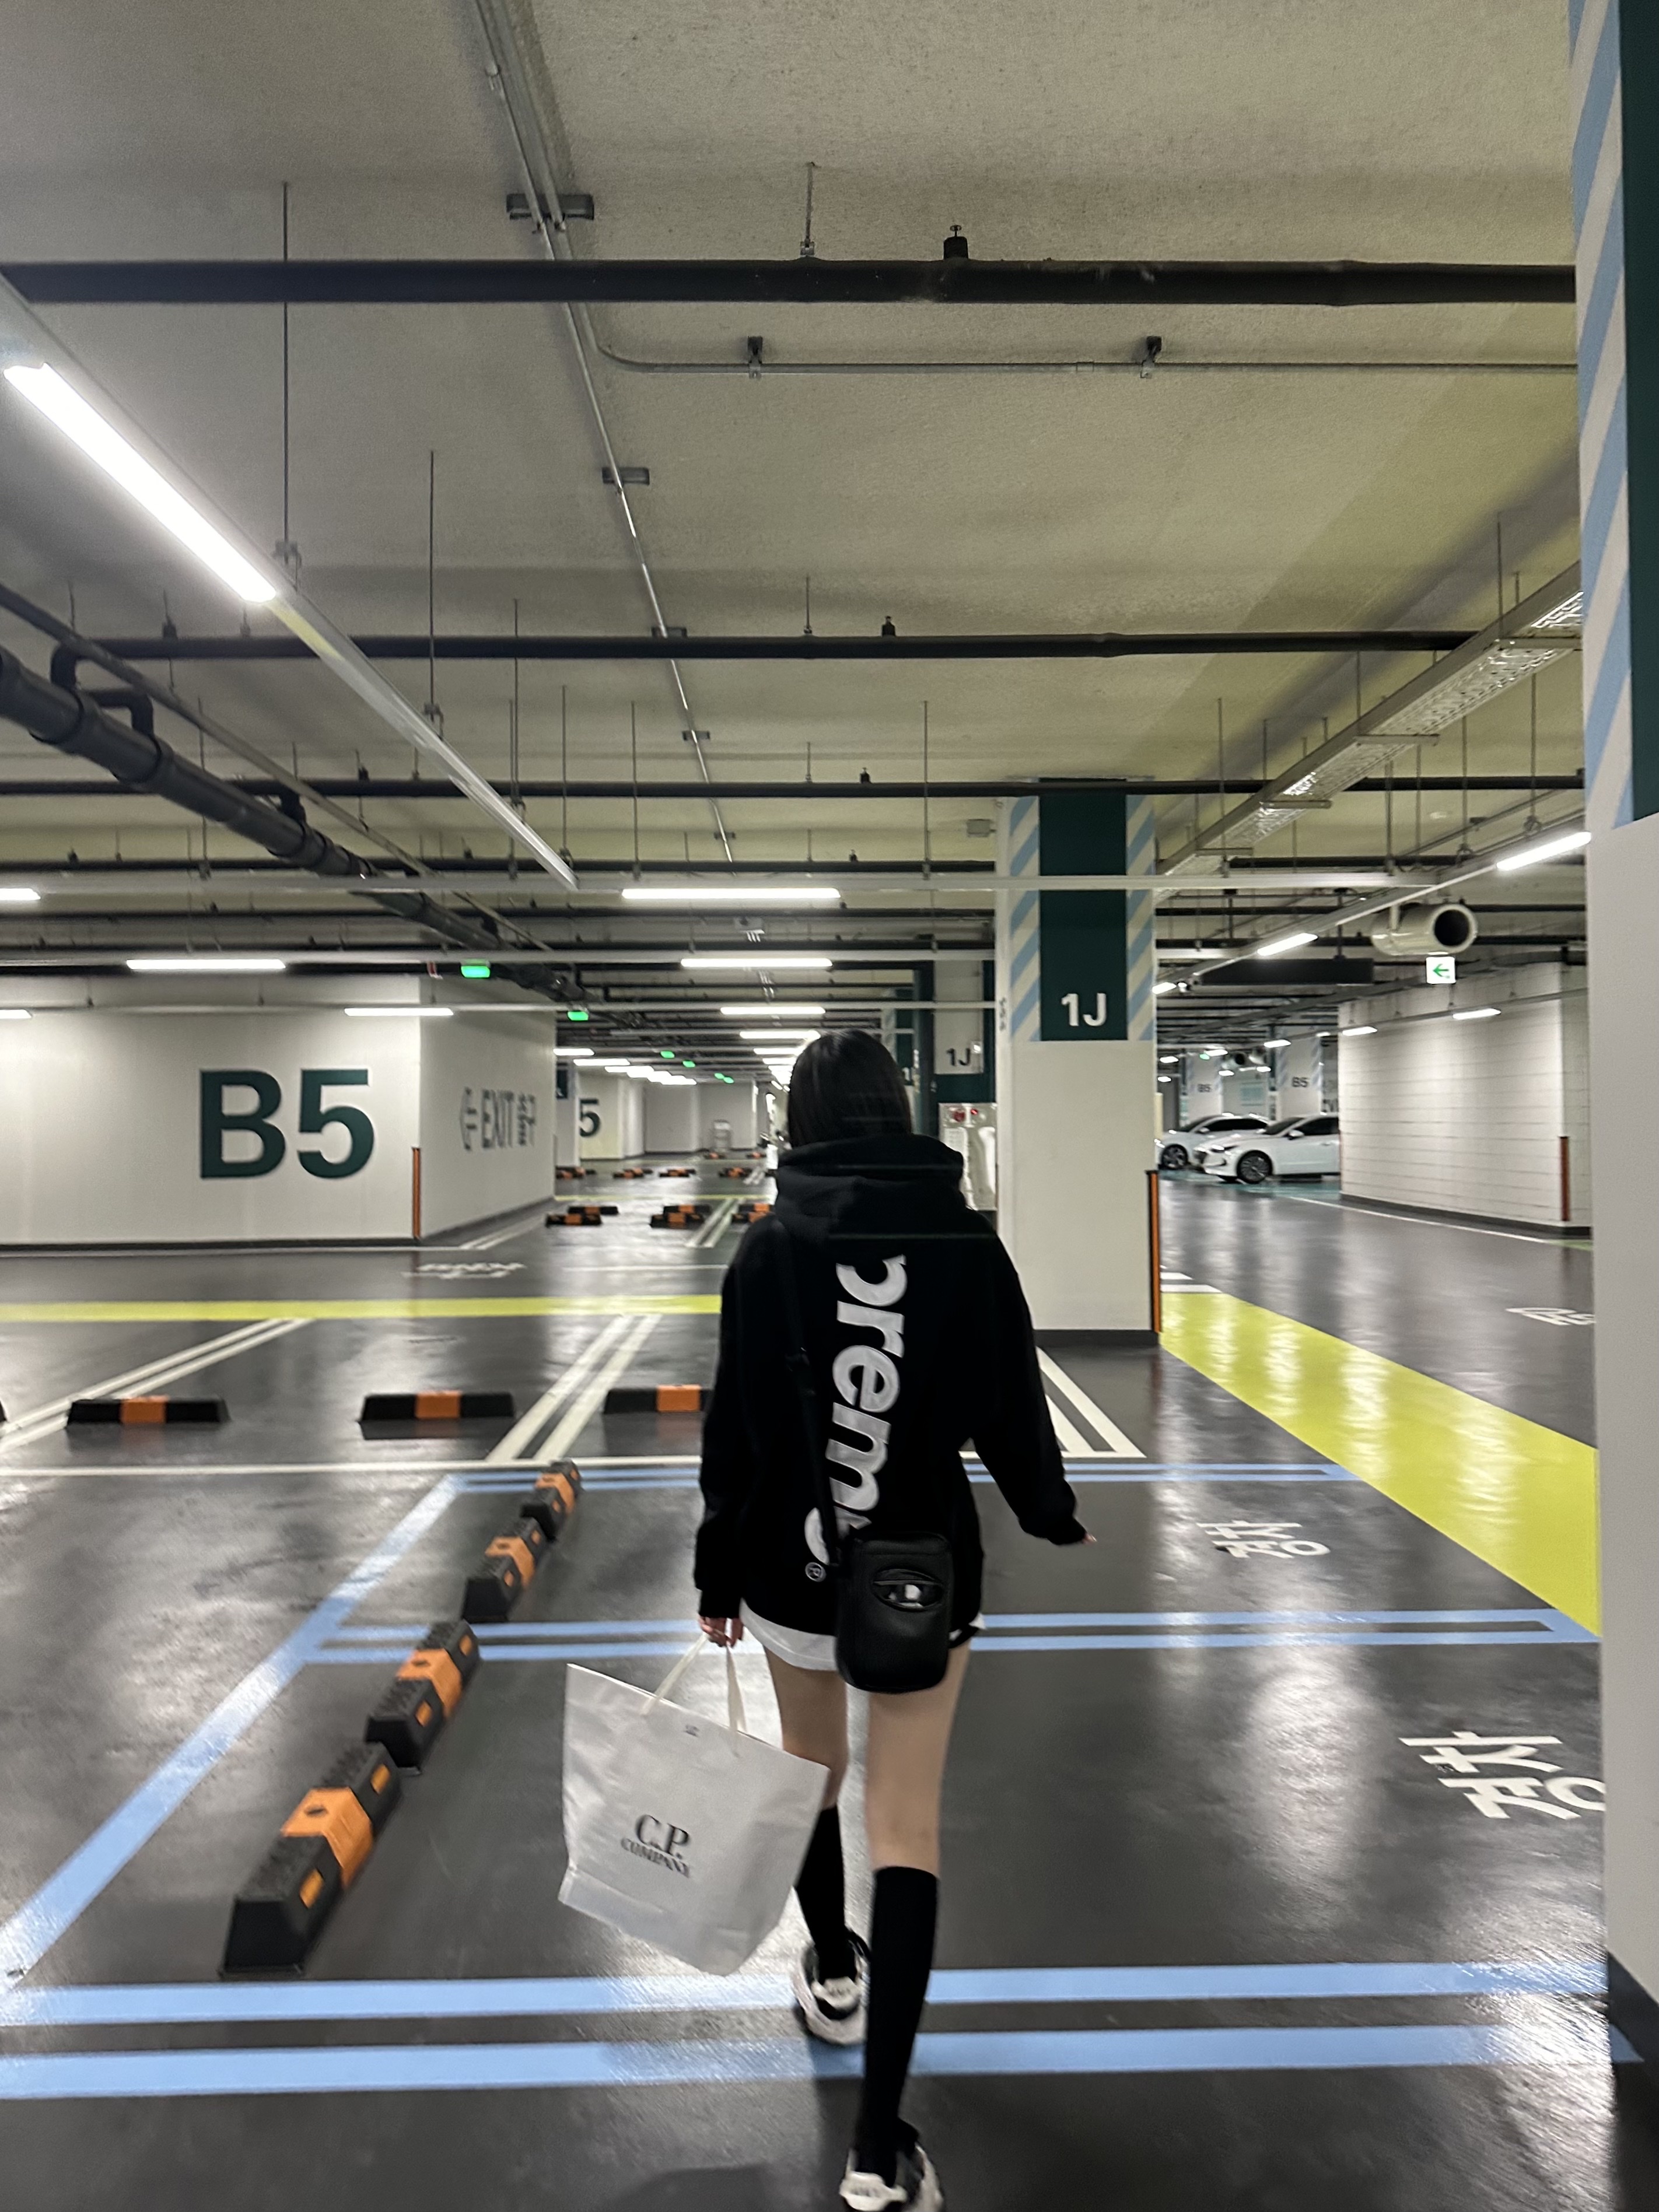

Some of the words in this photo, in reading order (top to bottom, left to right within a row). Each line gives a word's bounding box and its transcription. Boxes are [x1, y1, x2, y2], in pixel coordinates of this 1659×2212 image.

[1061, 993, 1106, 1026] 1J
[946, 1047, 971, 1067] 1J
[200, 1068, 374, 1179] B5
[481, 1088, 514, 1149] EXIT
[1196, 1520, 1331, 1559] 경차
[1398, 1731, 1605, 1820] 경차
